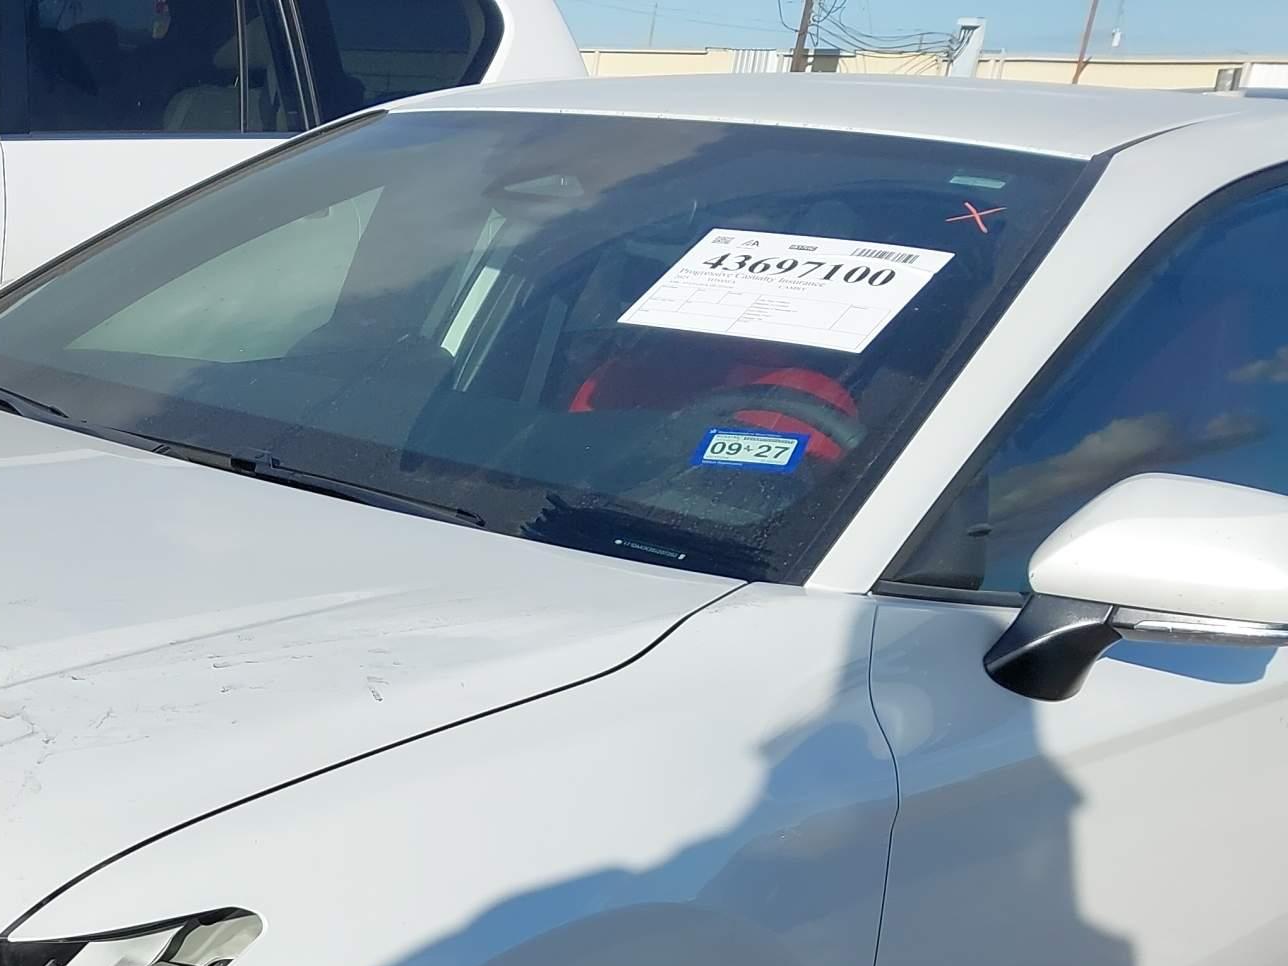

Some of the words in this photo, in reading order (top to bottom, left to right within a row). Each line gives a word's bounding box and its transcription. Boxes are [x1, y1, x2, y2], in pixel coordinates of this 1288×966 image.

[680, 267, 734, 278] Progressive
[735, 272, 775, 283] Casualty
[778, 277, 825, 288] Insurance
[702, 252, 896, 287] 43697100
[710, 441, 742, 456] 09
[753, 444, 790, 459] 27
